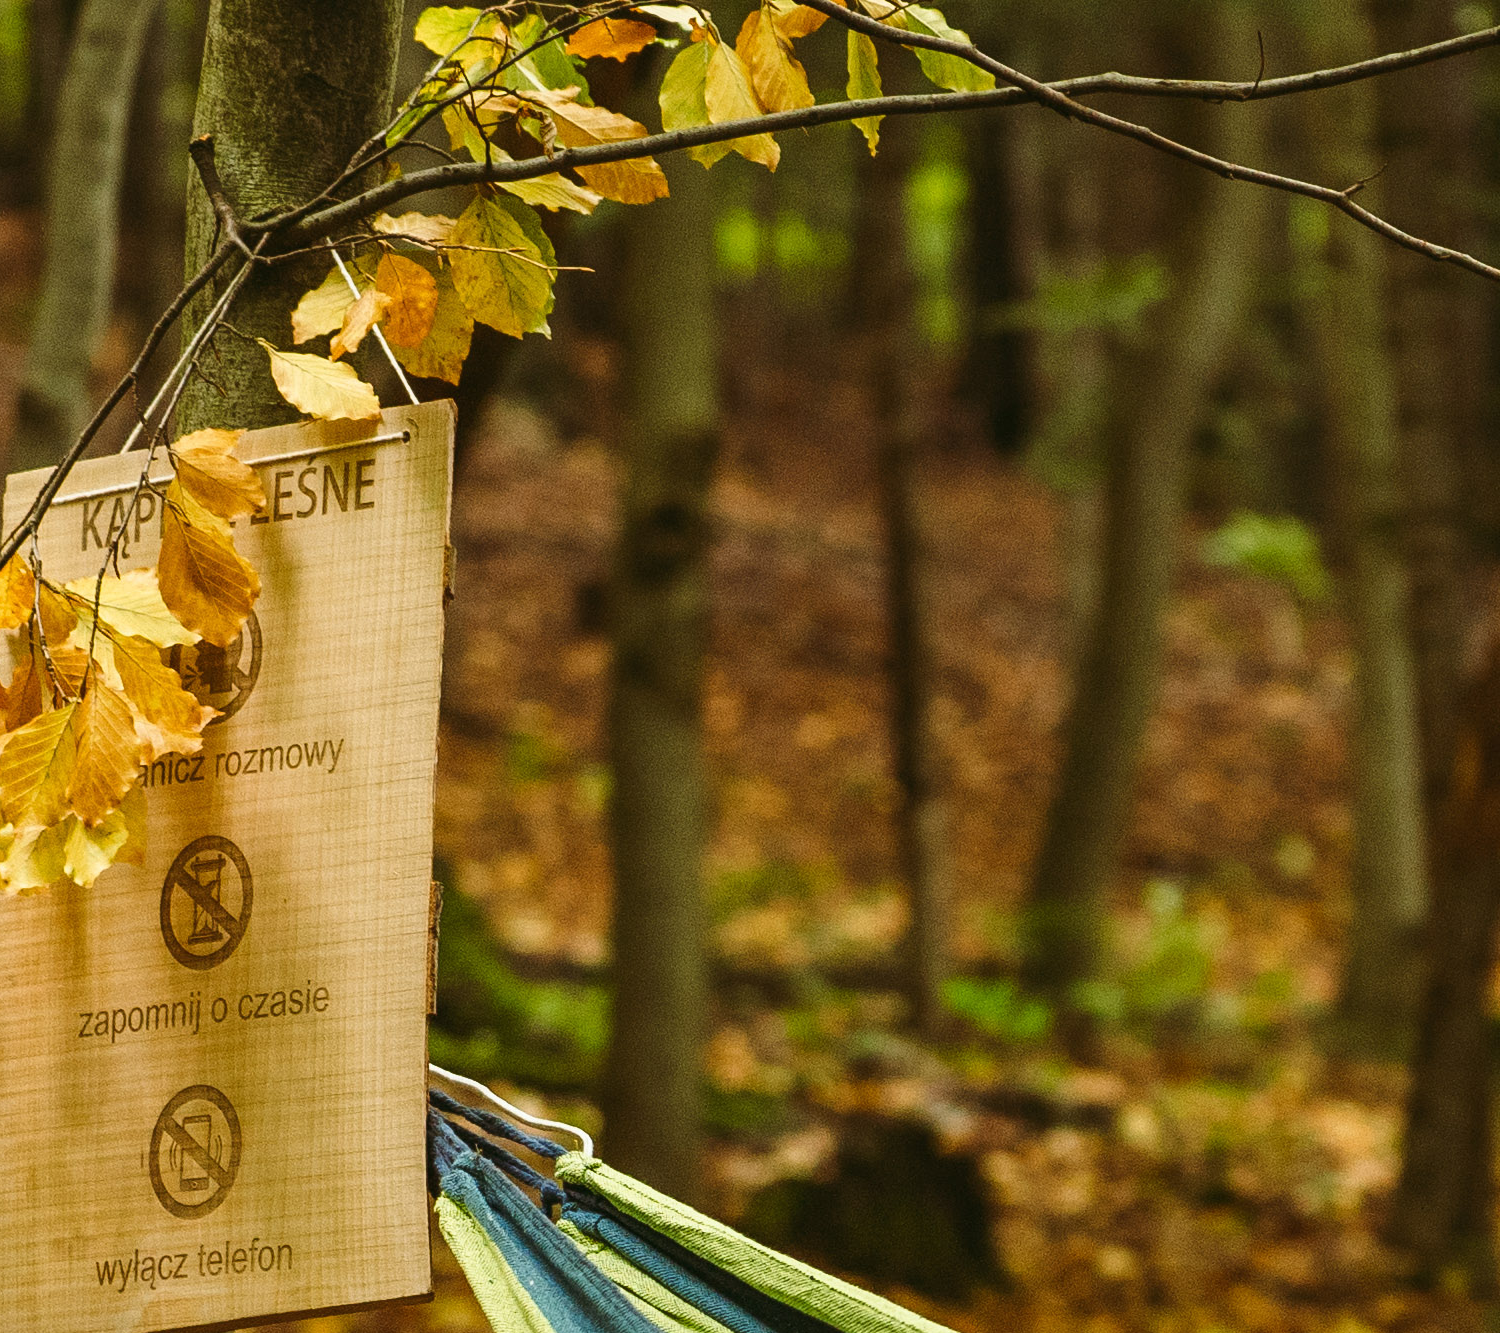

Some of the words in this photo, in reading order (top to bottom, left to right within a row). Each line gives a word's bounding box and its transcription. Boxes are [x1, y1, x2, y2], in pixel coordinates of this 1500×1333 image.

[82, 489, 236, 559] KĄPI
[133, 751, 205, 789] anicz
[214, 738, 344, 778] rozmowy
[78, 991, 202, 1044] zapomnij
[211, 997, 229, 1024] o
[238, 979, 330, 1021] czasie
[96, 1248, 189, 1294] wyłącz
[197, 1237, 293, 1278] telefon
